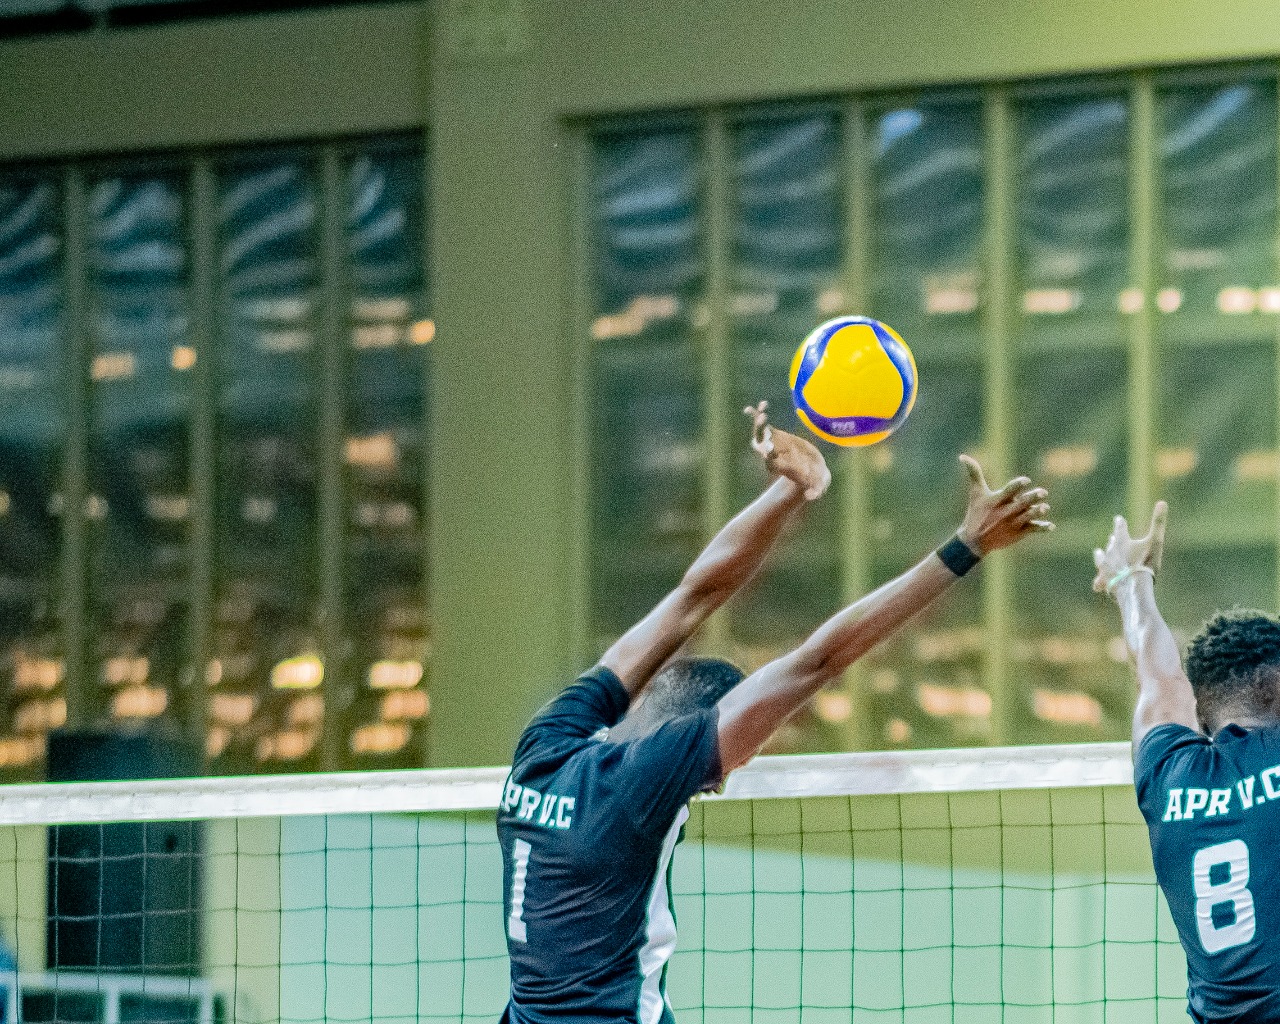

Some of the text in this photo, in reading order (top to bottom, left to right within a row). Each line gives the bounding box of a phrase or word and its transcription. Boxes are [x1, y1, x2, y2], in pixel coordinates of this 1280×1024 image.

[500, 779, 576, 830] PR V.C
[1162, 787, 1232, 822] APR
[508, 838, 532, 943] 1
[1192, 838, 1257, 955] 8
